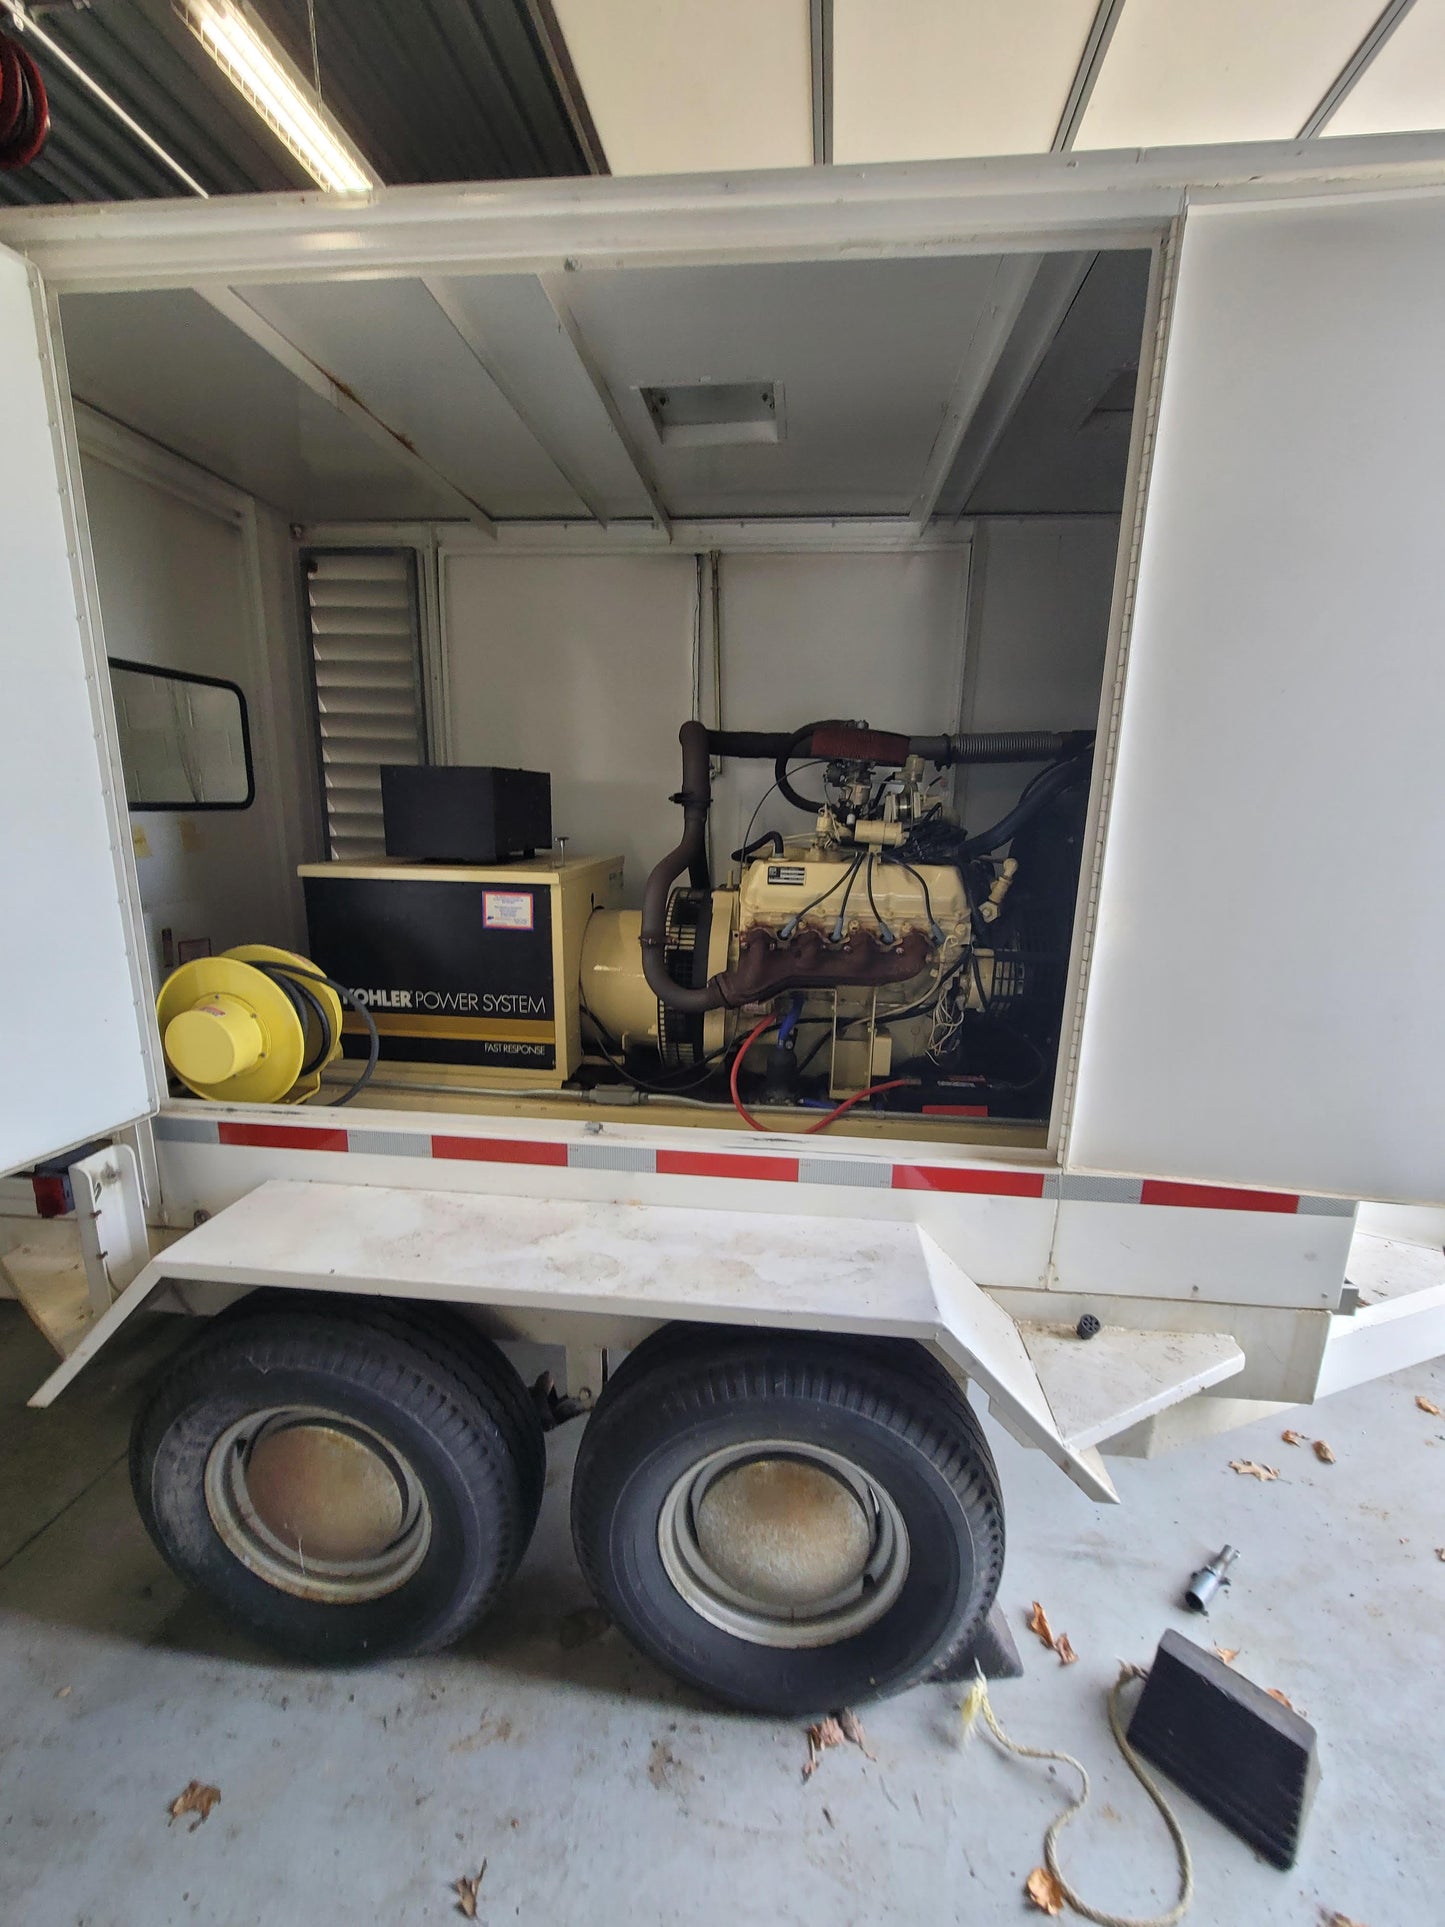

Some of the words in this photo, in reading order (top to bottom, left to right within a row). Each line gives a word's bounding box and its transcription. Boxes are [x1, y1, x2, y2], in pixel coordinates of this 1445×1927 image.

[415, 991, 479, 1011] POWER
[482, 993, 546, 1013] SYSTEM
[484, 1043, 502, 1053] FAST
[503, 1044, 545, 1055] RESPONSE
